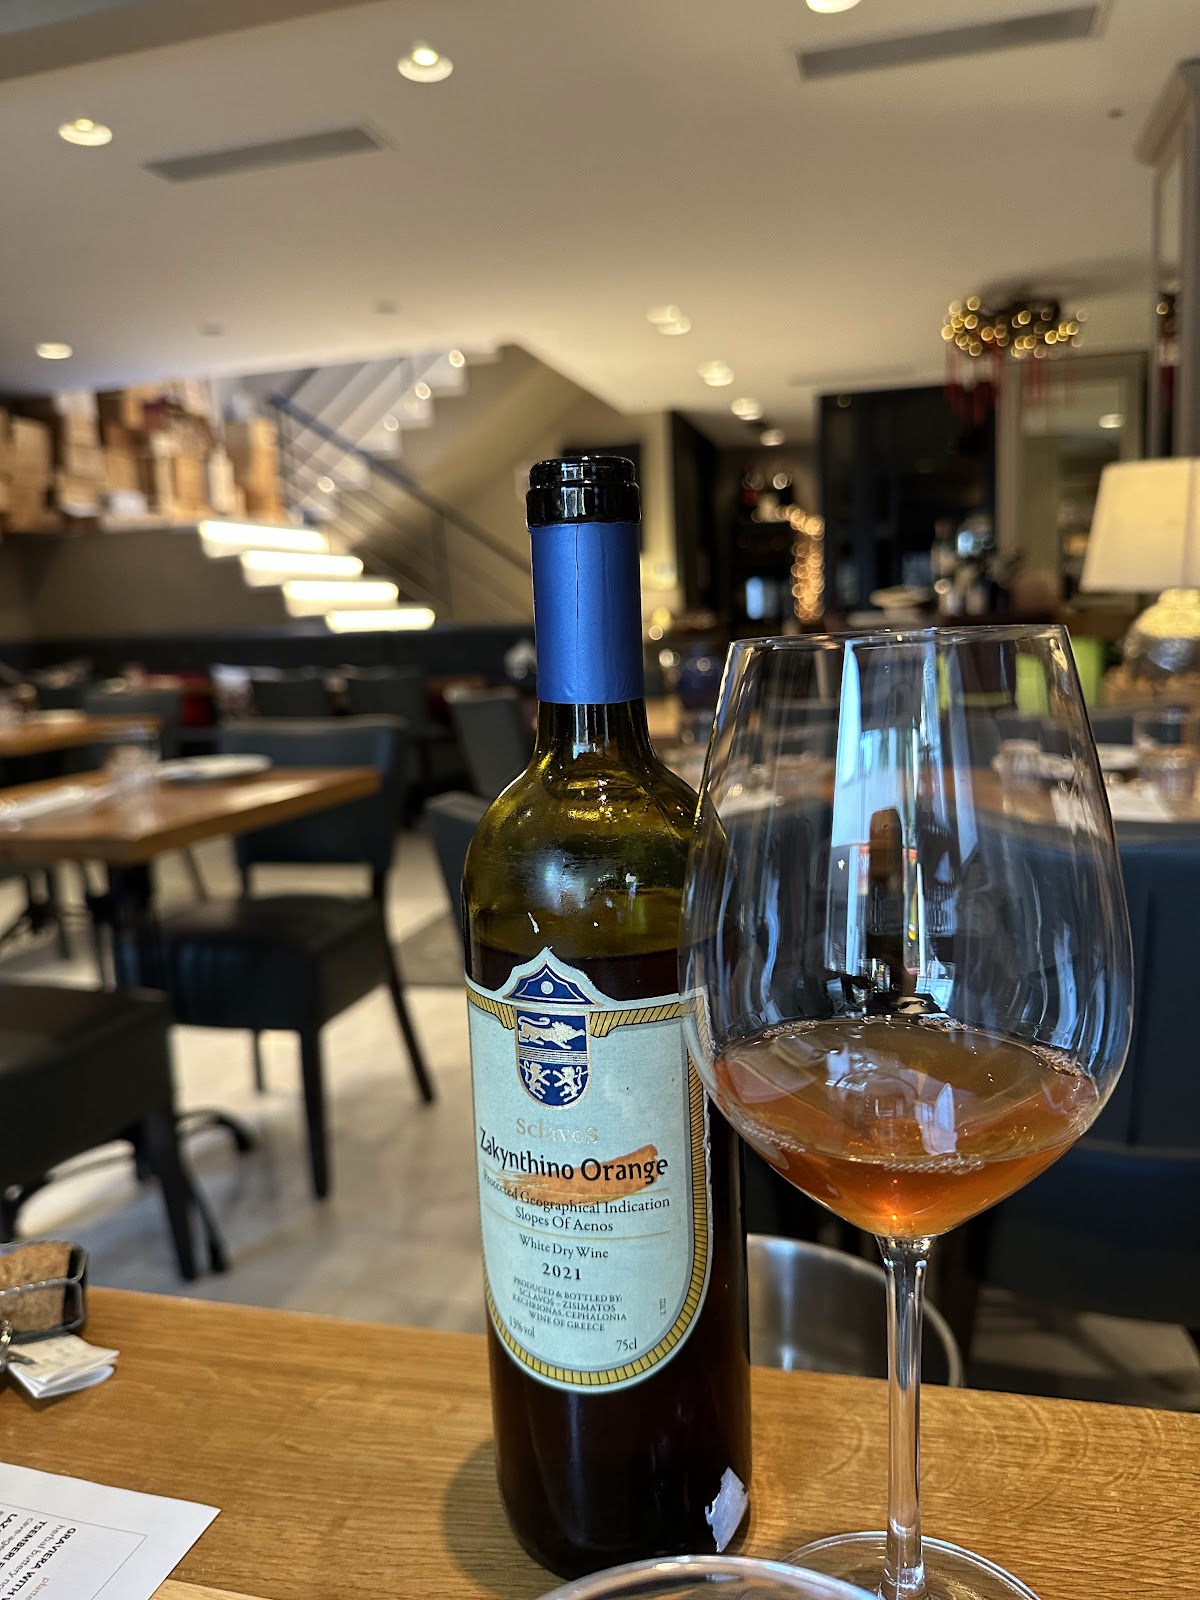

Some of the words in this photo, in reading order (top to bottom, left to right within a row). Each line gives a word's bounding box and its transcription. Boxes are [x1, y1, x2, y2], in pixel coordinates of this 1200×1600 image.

[480, 1126, 574, 1180] Zakynthino
[580, 1157, 669, 1184] Orange
[483, 1168, 518, 1200] Protected
[520, 1190, 600, 1215] Geographical
[604, 1197, 670, 1214] Indication
[515, 1206, 549, 1227] Slopes
[552, 1215, 571, 1230] Of
[573, 1220, 614, 1232] Aenos
[519, 1233, 550, 1254] White
[552, 1243, 574, 1260] Dry
[576, 1246, 609, 1259] Wine
[542, 1262, 582, 1280] 2021
[513, 1275, 555, 1297] PRODUCED
[564, 1291, 609, 1302] BOTTLED
[519, 1287, 555, 1306] SCLAVOS
[562, 1300, 616, 1312] ZISIMATOS
[529, 1310, 554, 1325] WINE
[554, 1318, 566, 1327] OF
[566, 1320, 606, 1332] GREECE
[565, 1309, 627, 1321] CEPHALONIA
[616, 1337, 638, 1352] 75cl
[3, 1520, 48, 1561] TSEMBERI
[31, 1527, 77, 1570] GRAVIERA
[38, 1524, 66, 1549] herbal
[7, 1571, 36, 1596] WITH
